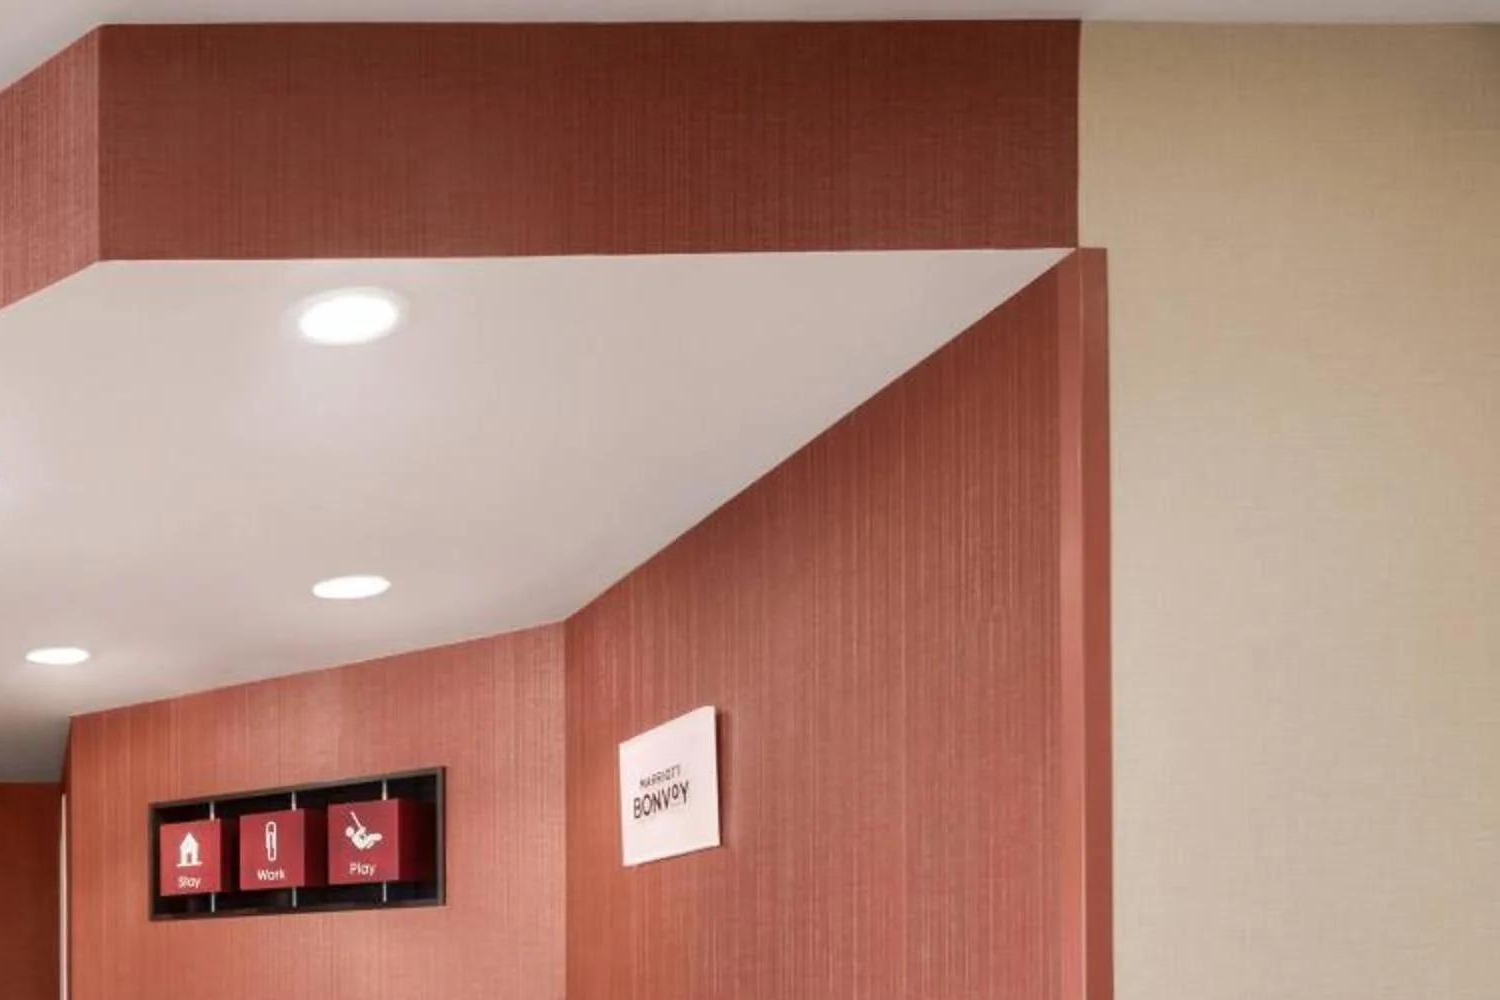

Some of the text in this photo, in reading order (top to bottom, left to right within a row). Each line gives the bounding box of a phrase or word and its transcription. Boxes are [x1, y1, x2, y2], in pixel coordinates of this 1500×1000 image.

[639, 764, 681, 788] MARRIOTT
[257, 868, 285, 881] Work
[349, 862, 377, 876] Play
[177, 874, 202, 889] Stay
